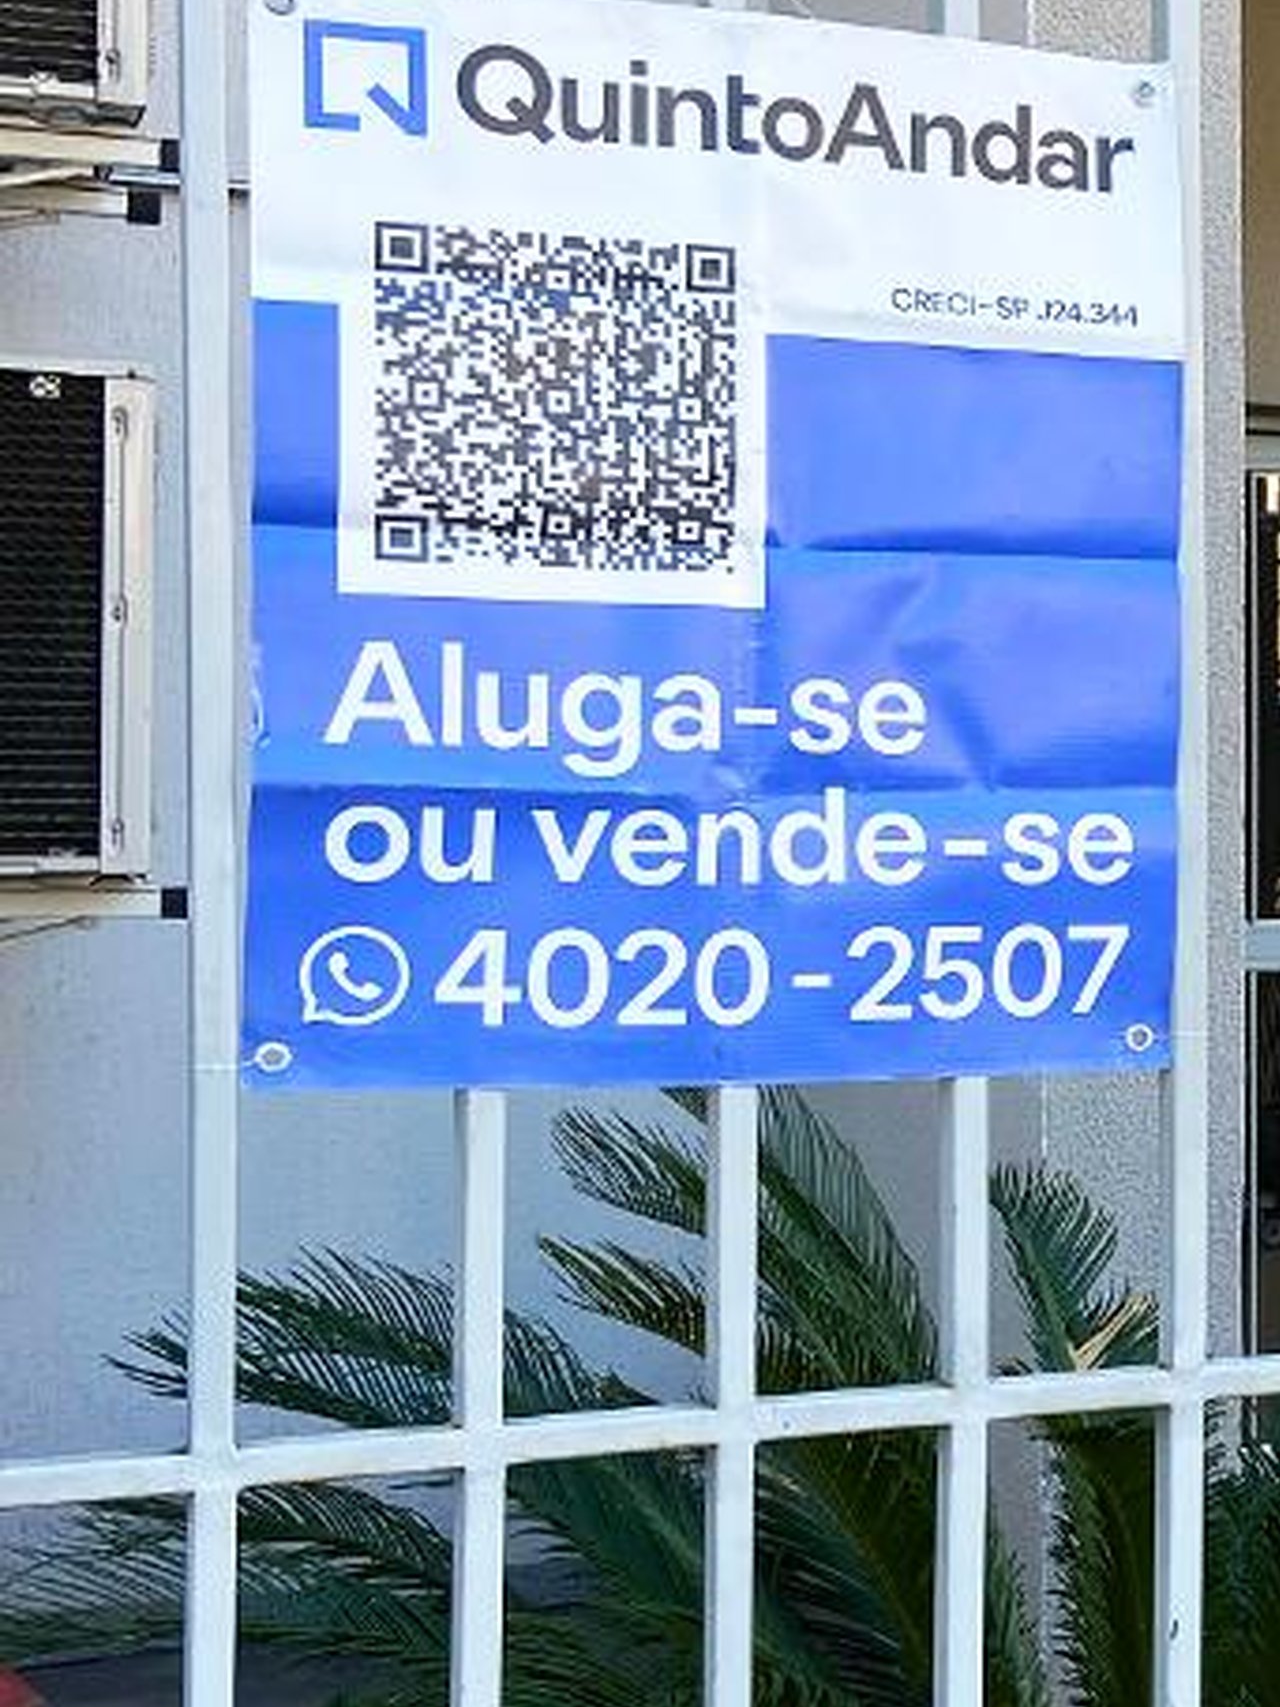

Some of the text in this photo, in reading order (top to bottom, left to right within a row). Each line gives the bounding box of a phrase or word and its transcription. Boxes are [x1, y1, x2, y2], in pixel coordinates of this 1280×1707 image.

[455, 44, 1135, 194] QuintoAndar
[325, 640, 926, 776] Aluga-se
[325, 788, 1136, 886] ou vende-se
